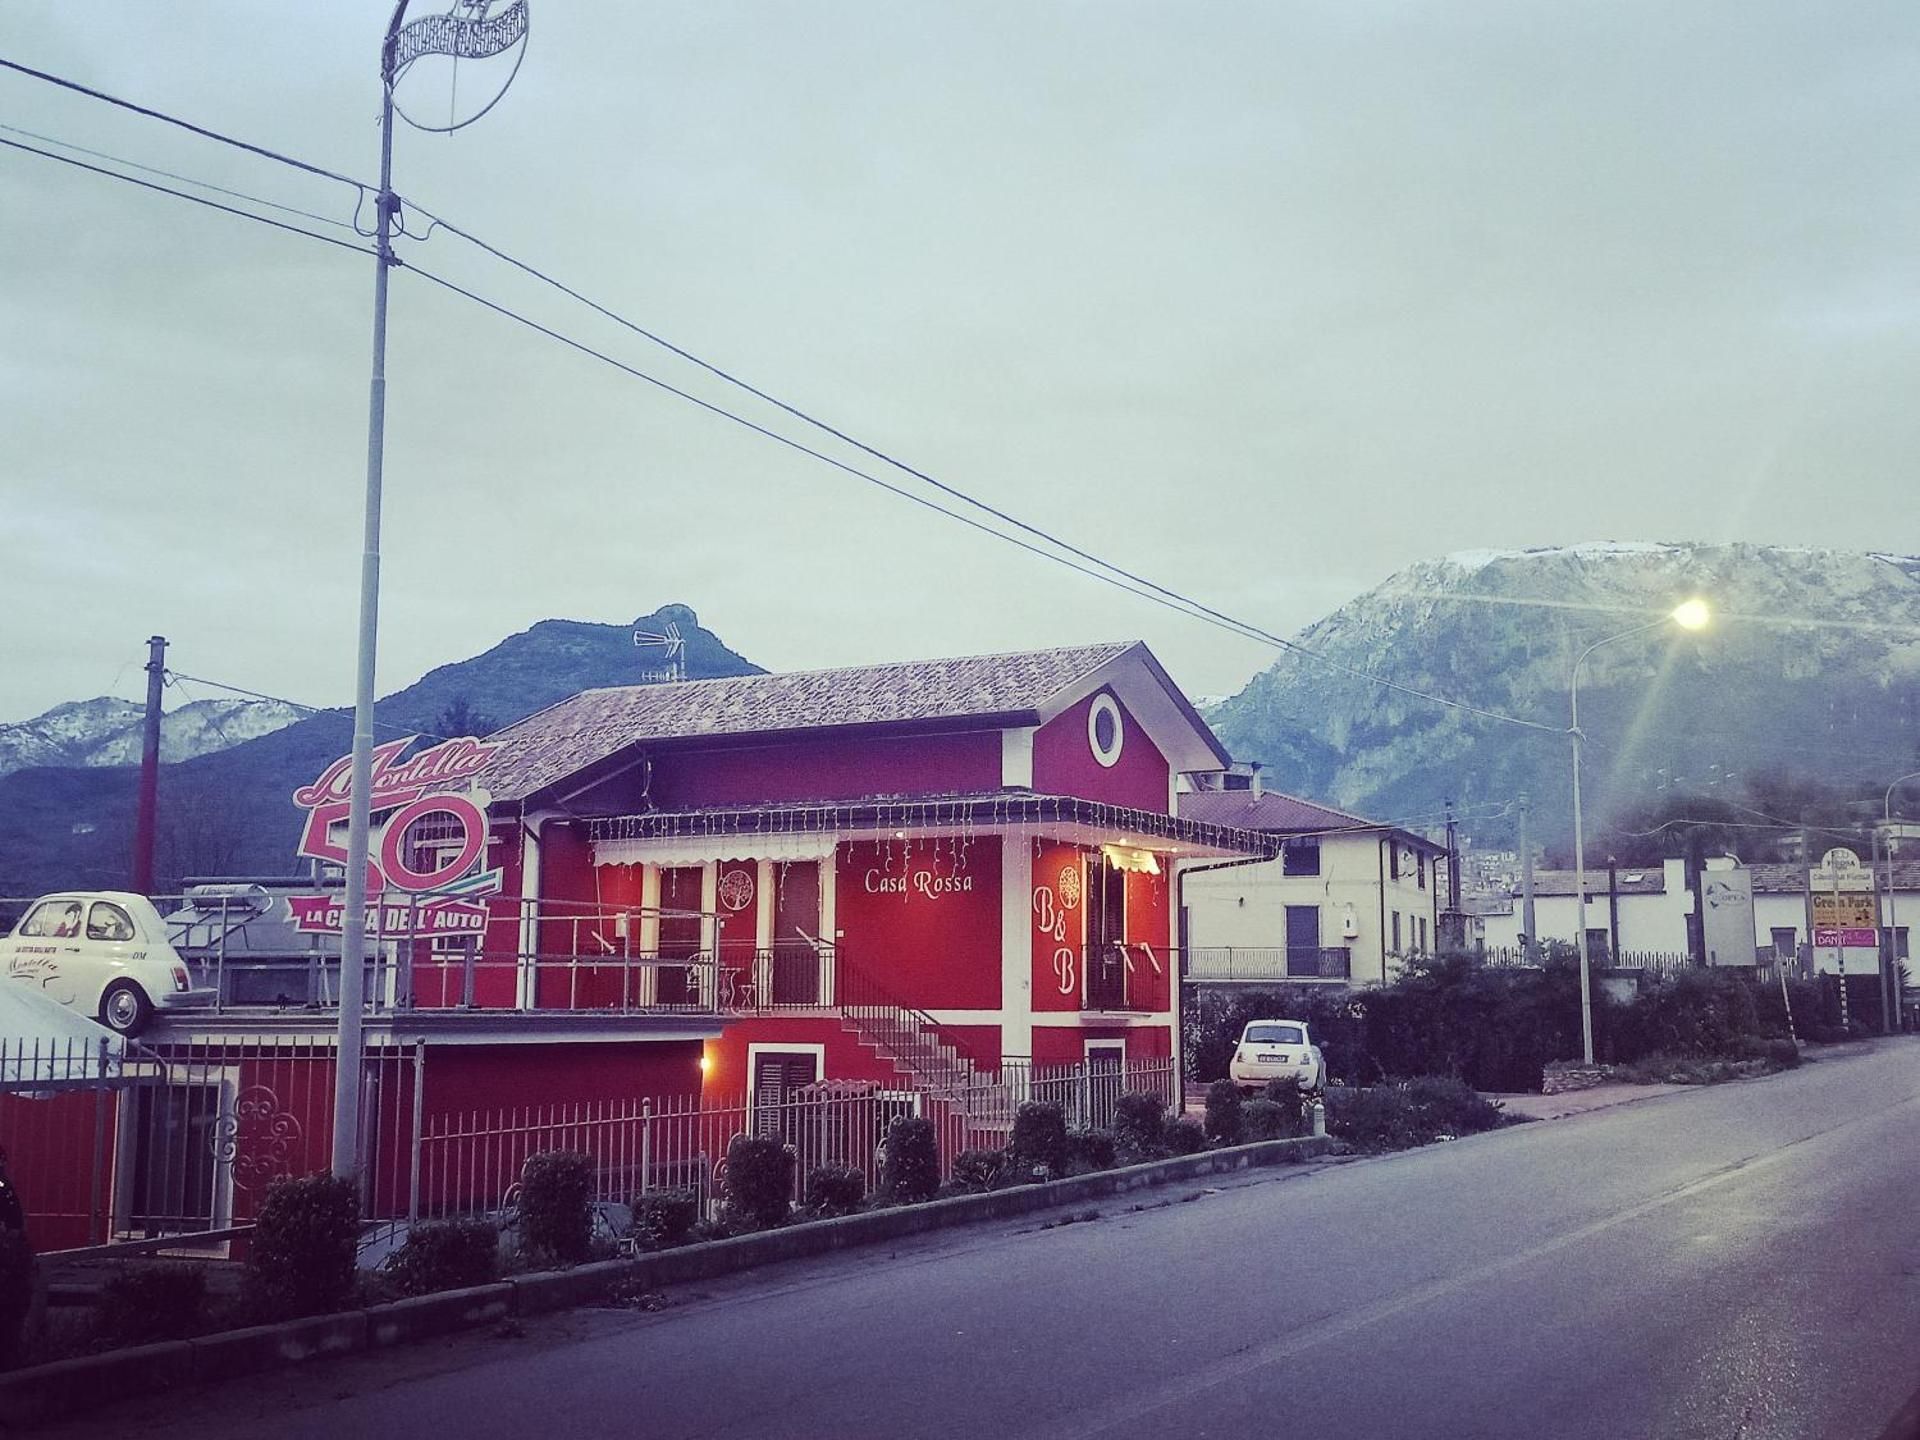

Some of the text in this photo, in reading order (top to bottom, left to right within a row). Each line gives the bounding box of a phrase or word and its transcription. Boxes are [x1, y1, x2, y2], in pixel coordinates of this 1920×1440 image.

[865, 868, 972, 900] Casa Rossa
[305, 910, 323, 923] LA
